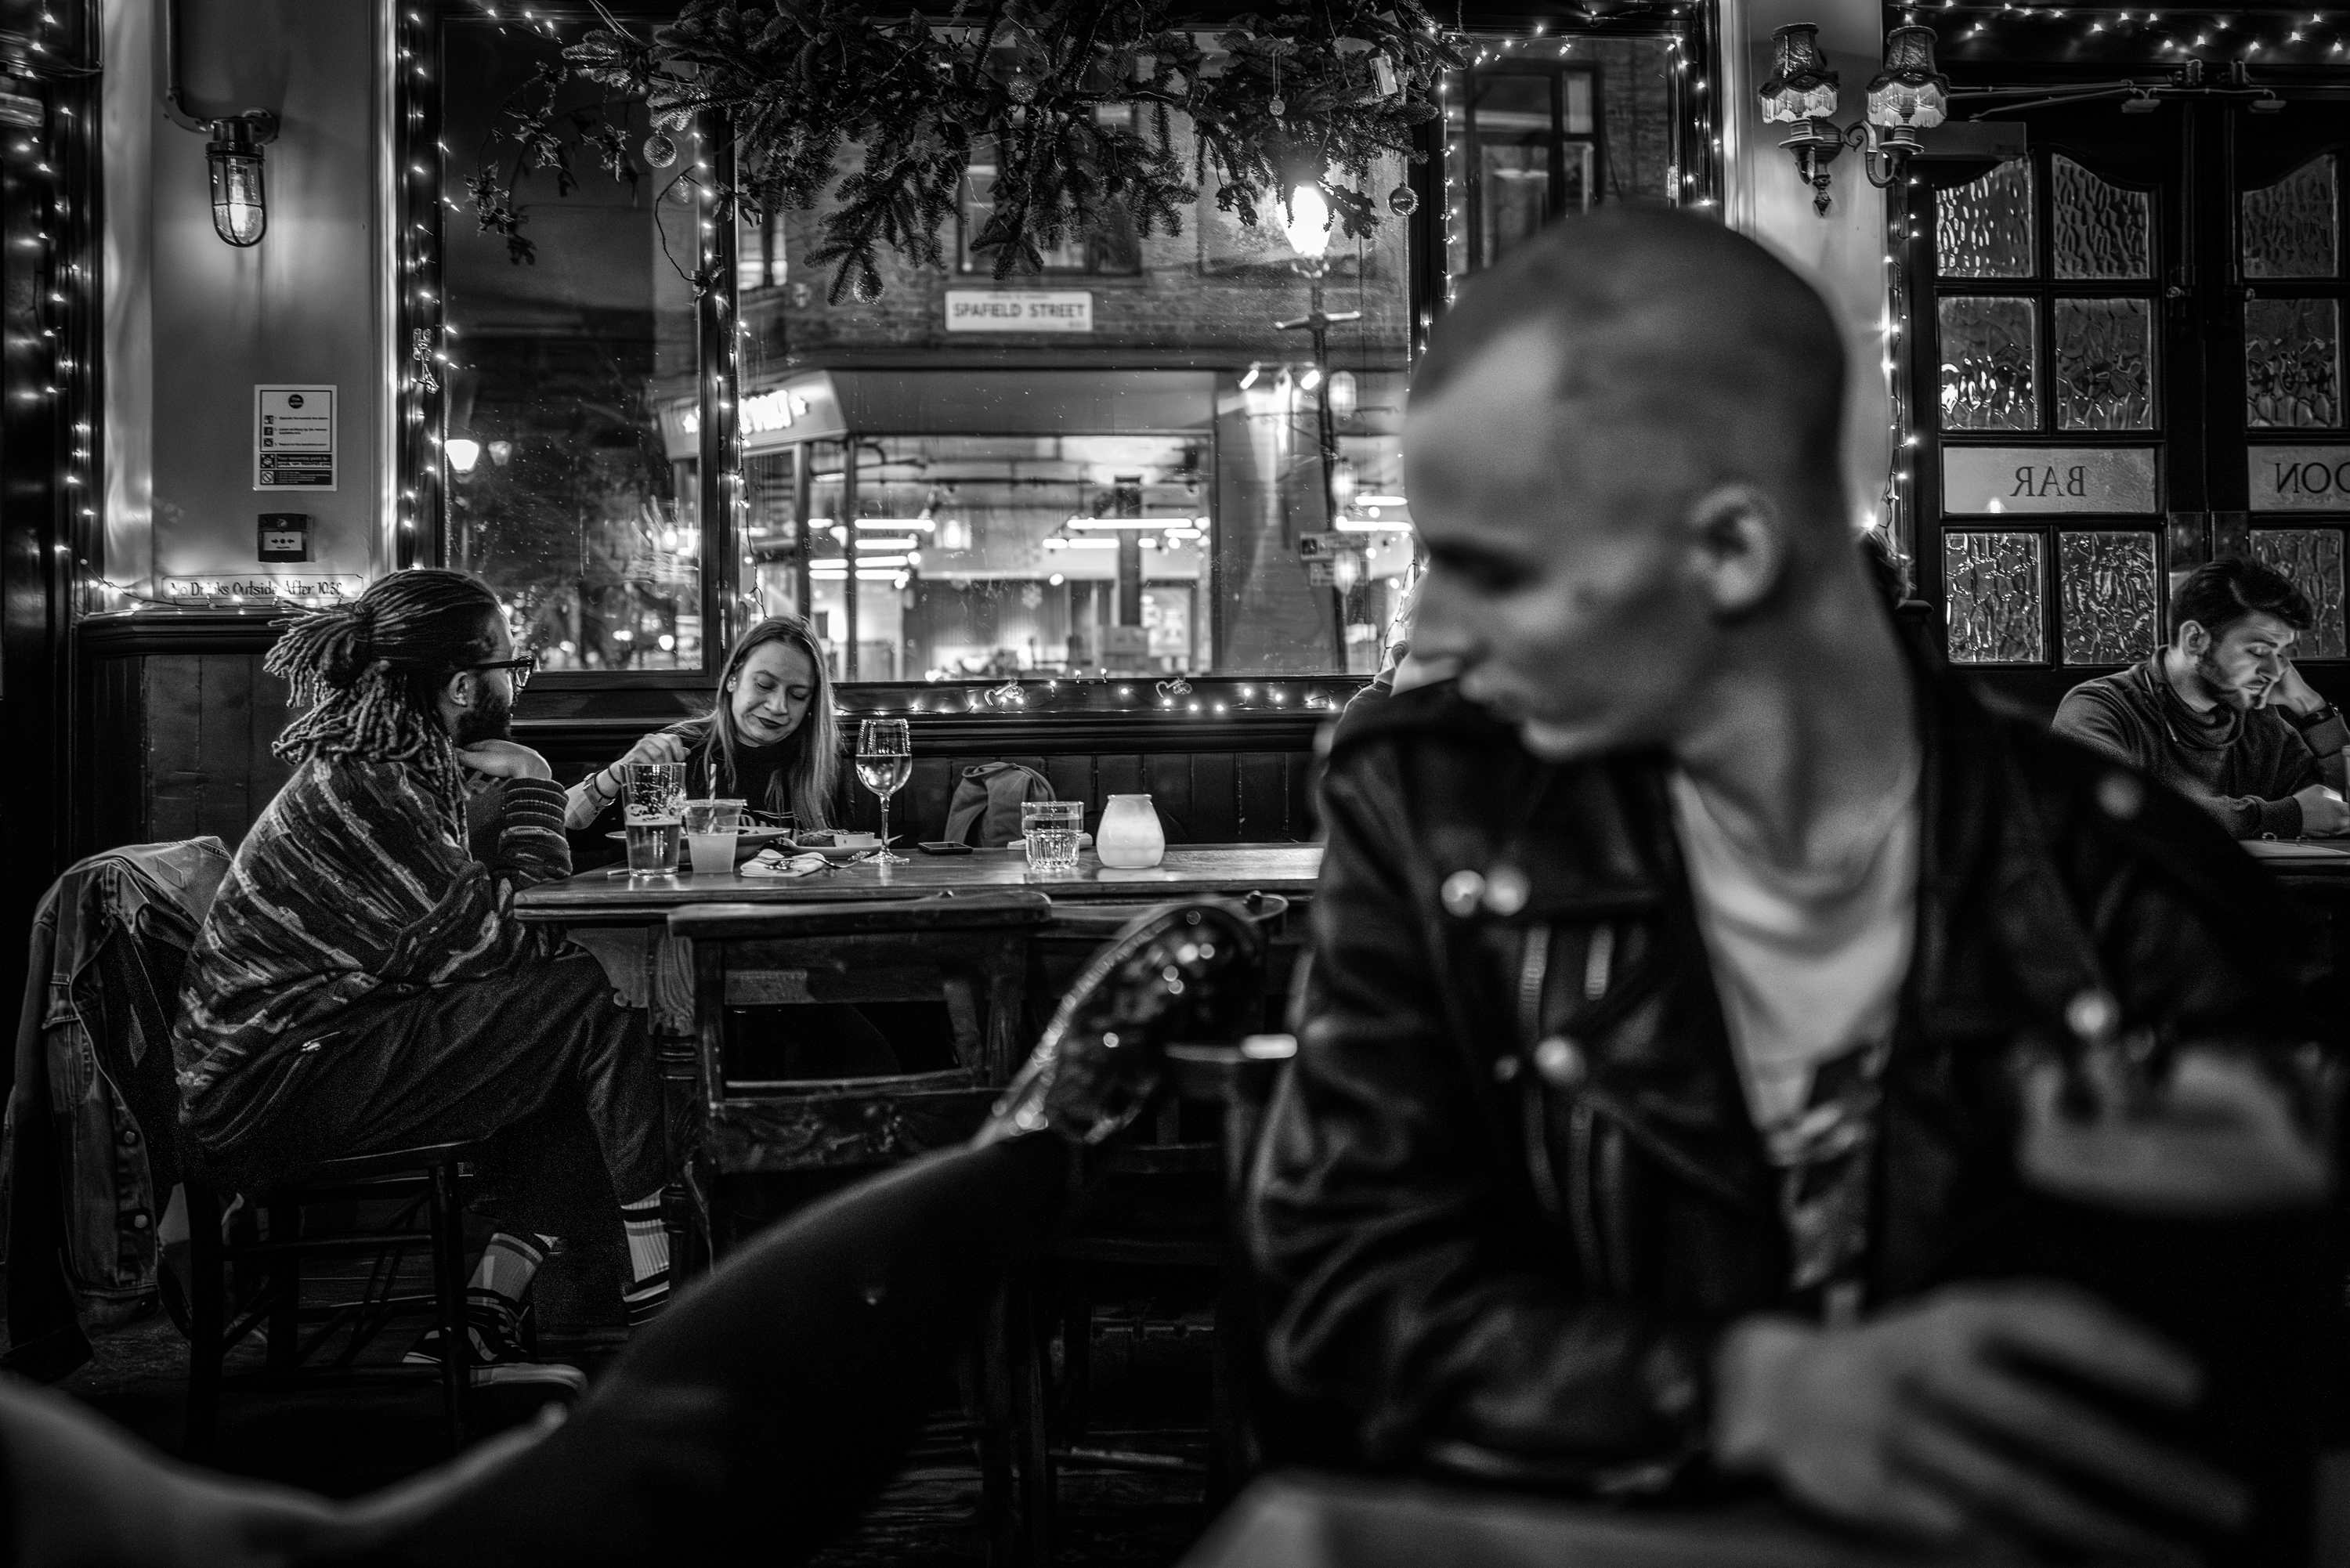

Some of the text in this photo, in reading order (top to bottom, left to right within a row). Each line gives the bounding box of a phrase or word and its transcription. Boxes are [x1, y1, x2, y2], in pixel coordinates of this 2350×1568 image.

[953, 302, 1084, 318] SPAFIELD STREET
[191, 581, 230, 595] Drks
[284, 580, 315, 595] After
